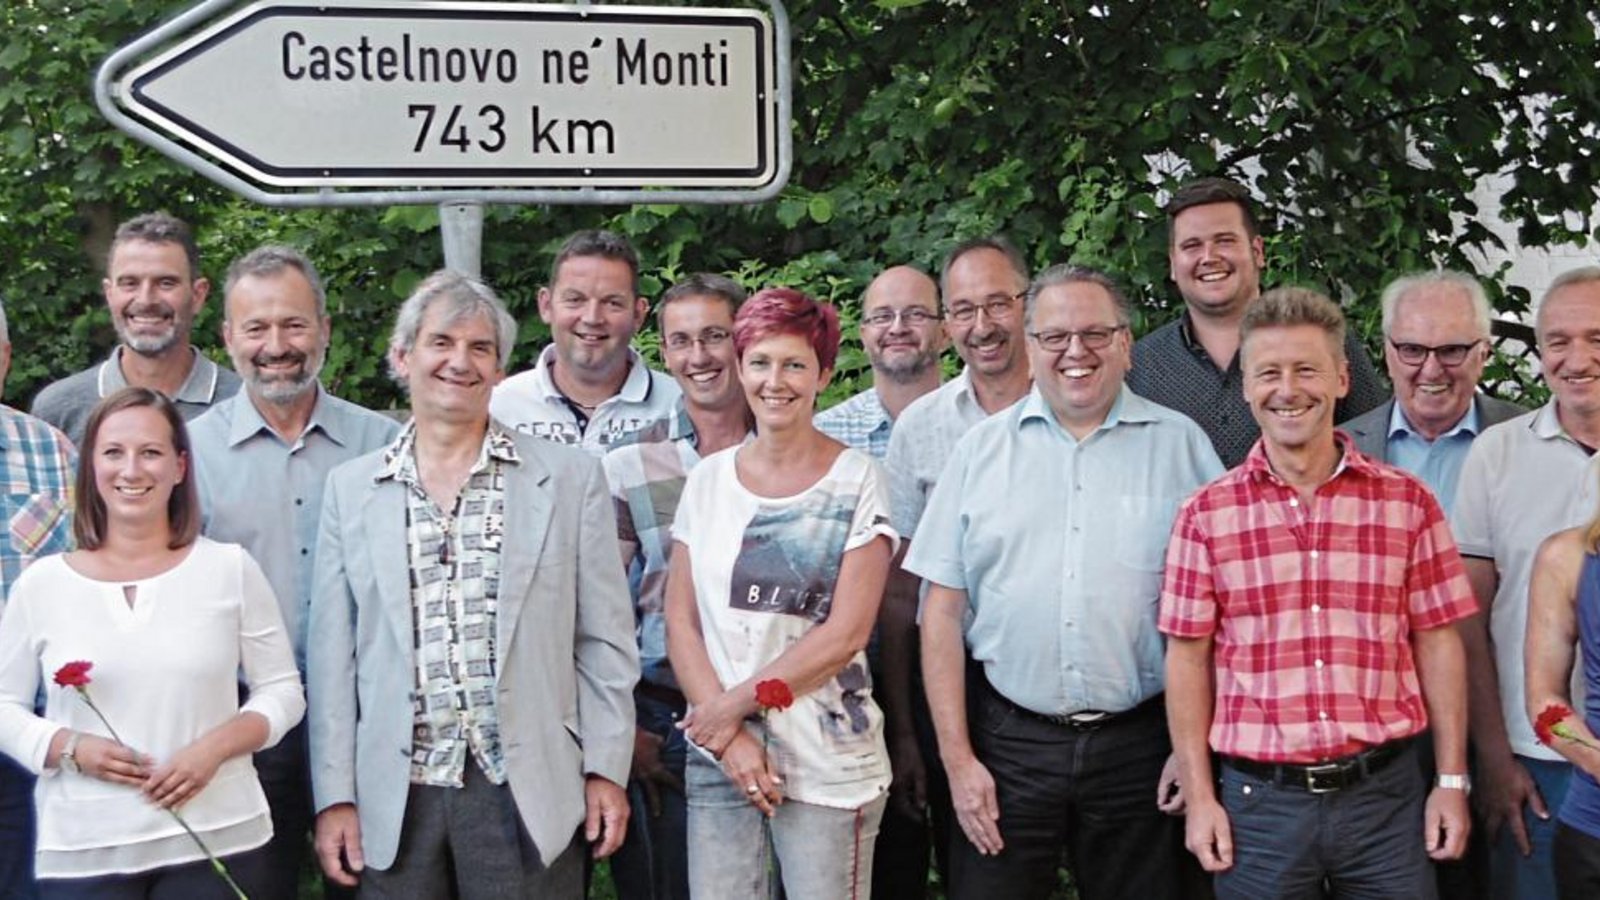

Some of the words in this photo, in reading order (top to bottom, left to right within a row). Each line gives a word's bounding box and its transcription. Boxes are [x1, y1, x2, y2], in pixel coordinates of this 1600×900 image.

[282, 31, 517, 84] Castelnovo
[616, 38, 729, 87] Monti
[408, 104, 506, 153] 743
[532, 105, 615, 154] km
